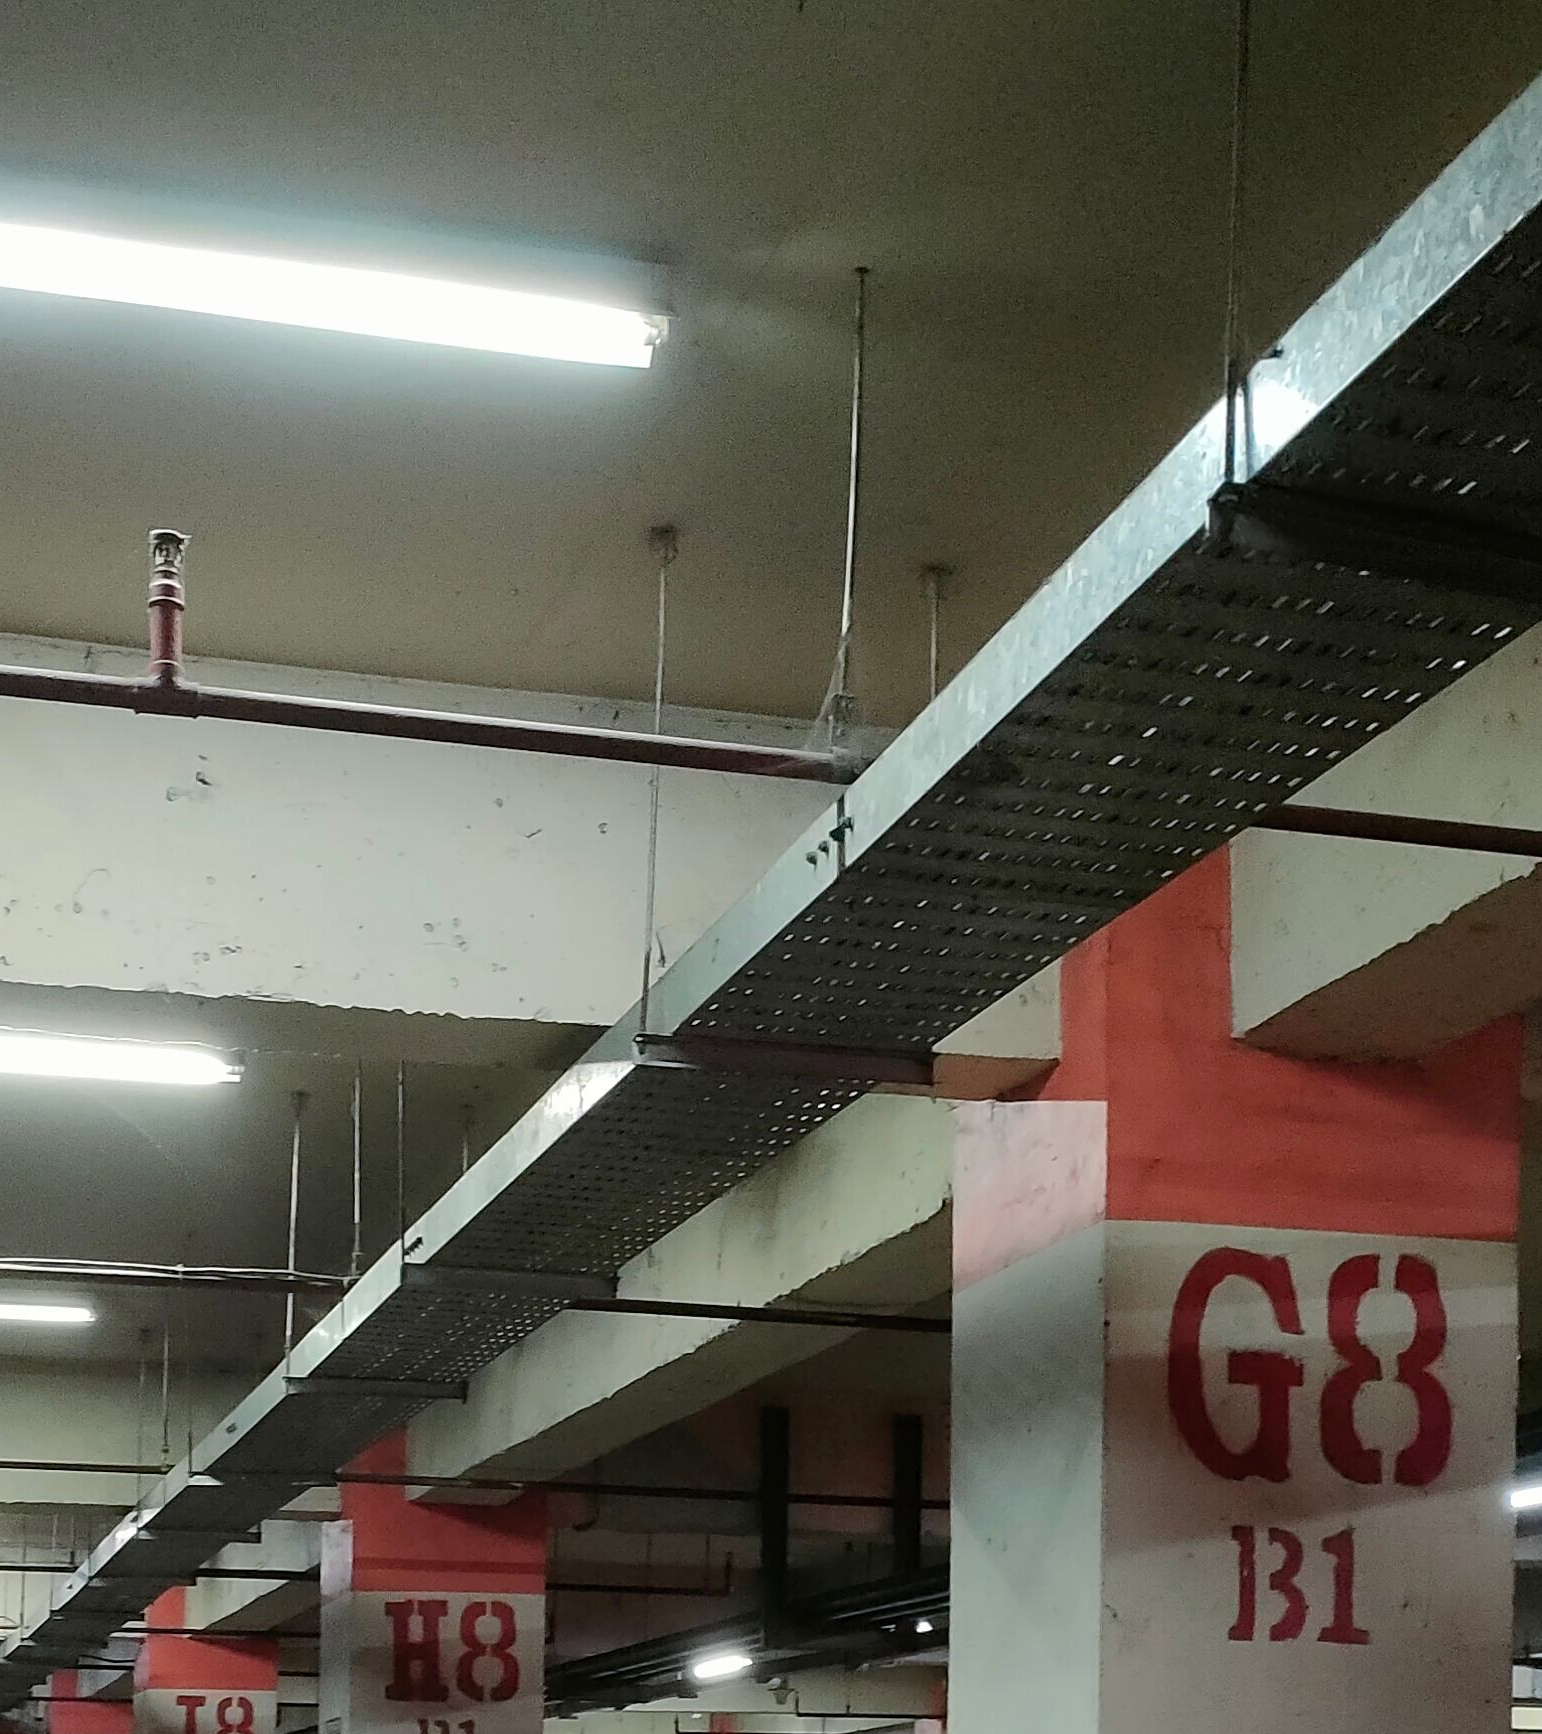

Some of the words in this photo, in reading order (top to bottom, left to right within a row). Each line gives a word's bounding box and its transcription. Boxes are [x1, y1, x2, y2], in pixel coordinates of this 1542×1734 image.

[1167, 1246, 1453, 1487] G8
[1227, 1525, 1371, 1646] B1
[384, 1599, 521, 1702] H8
